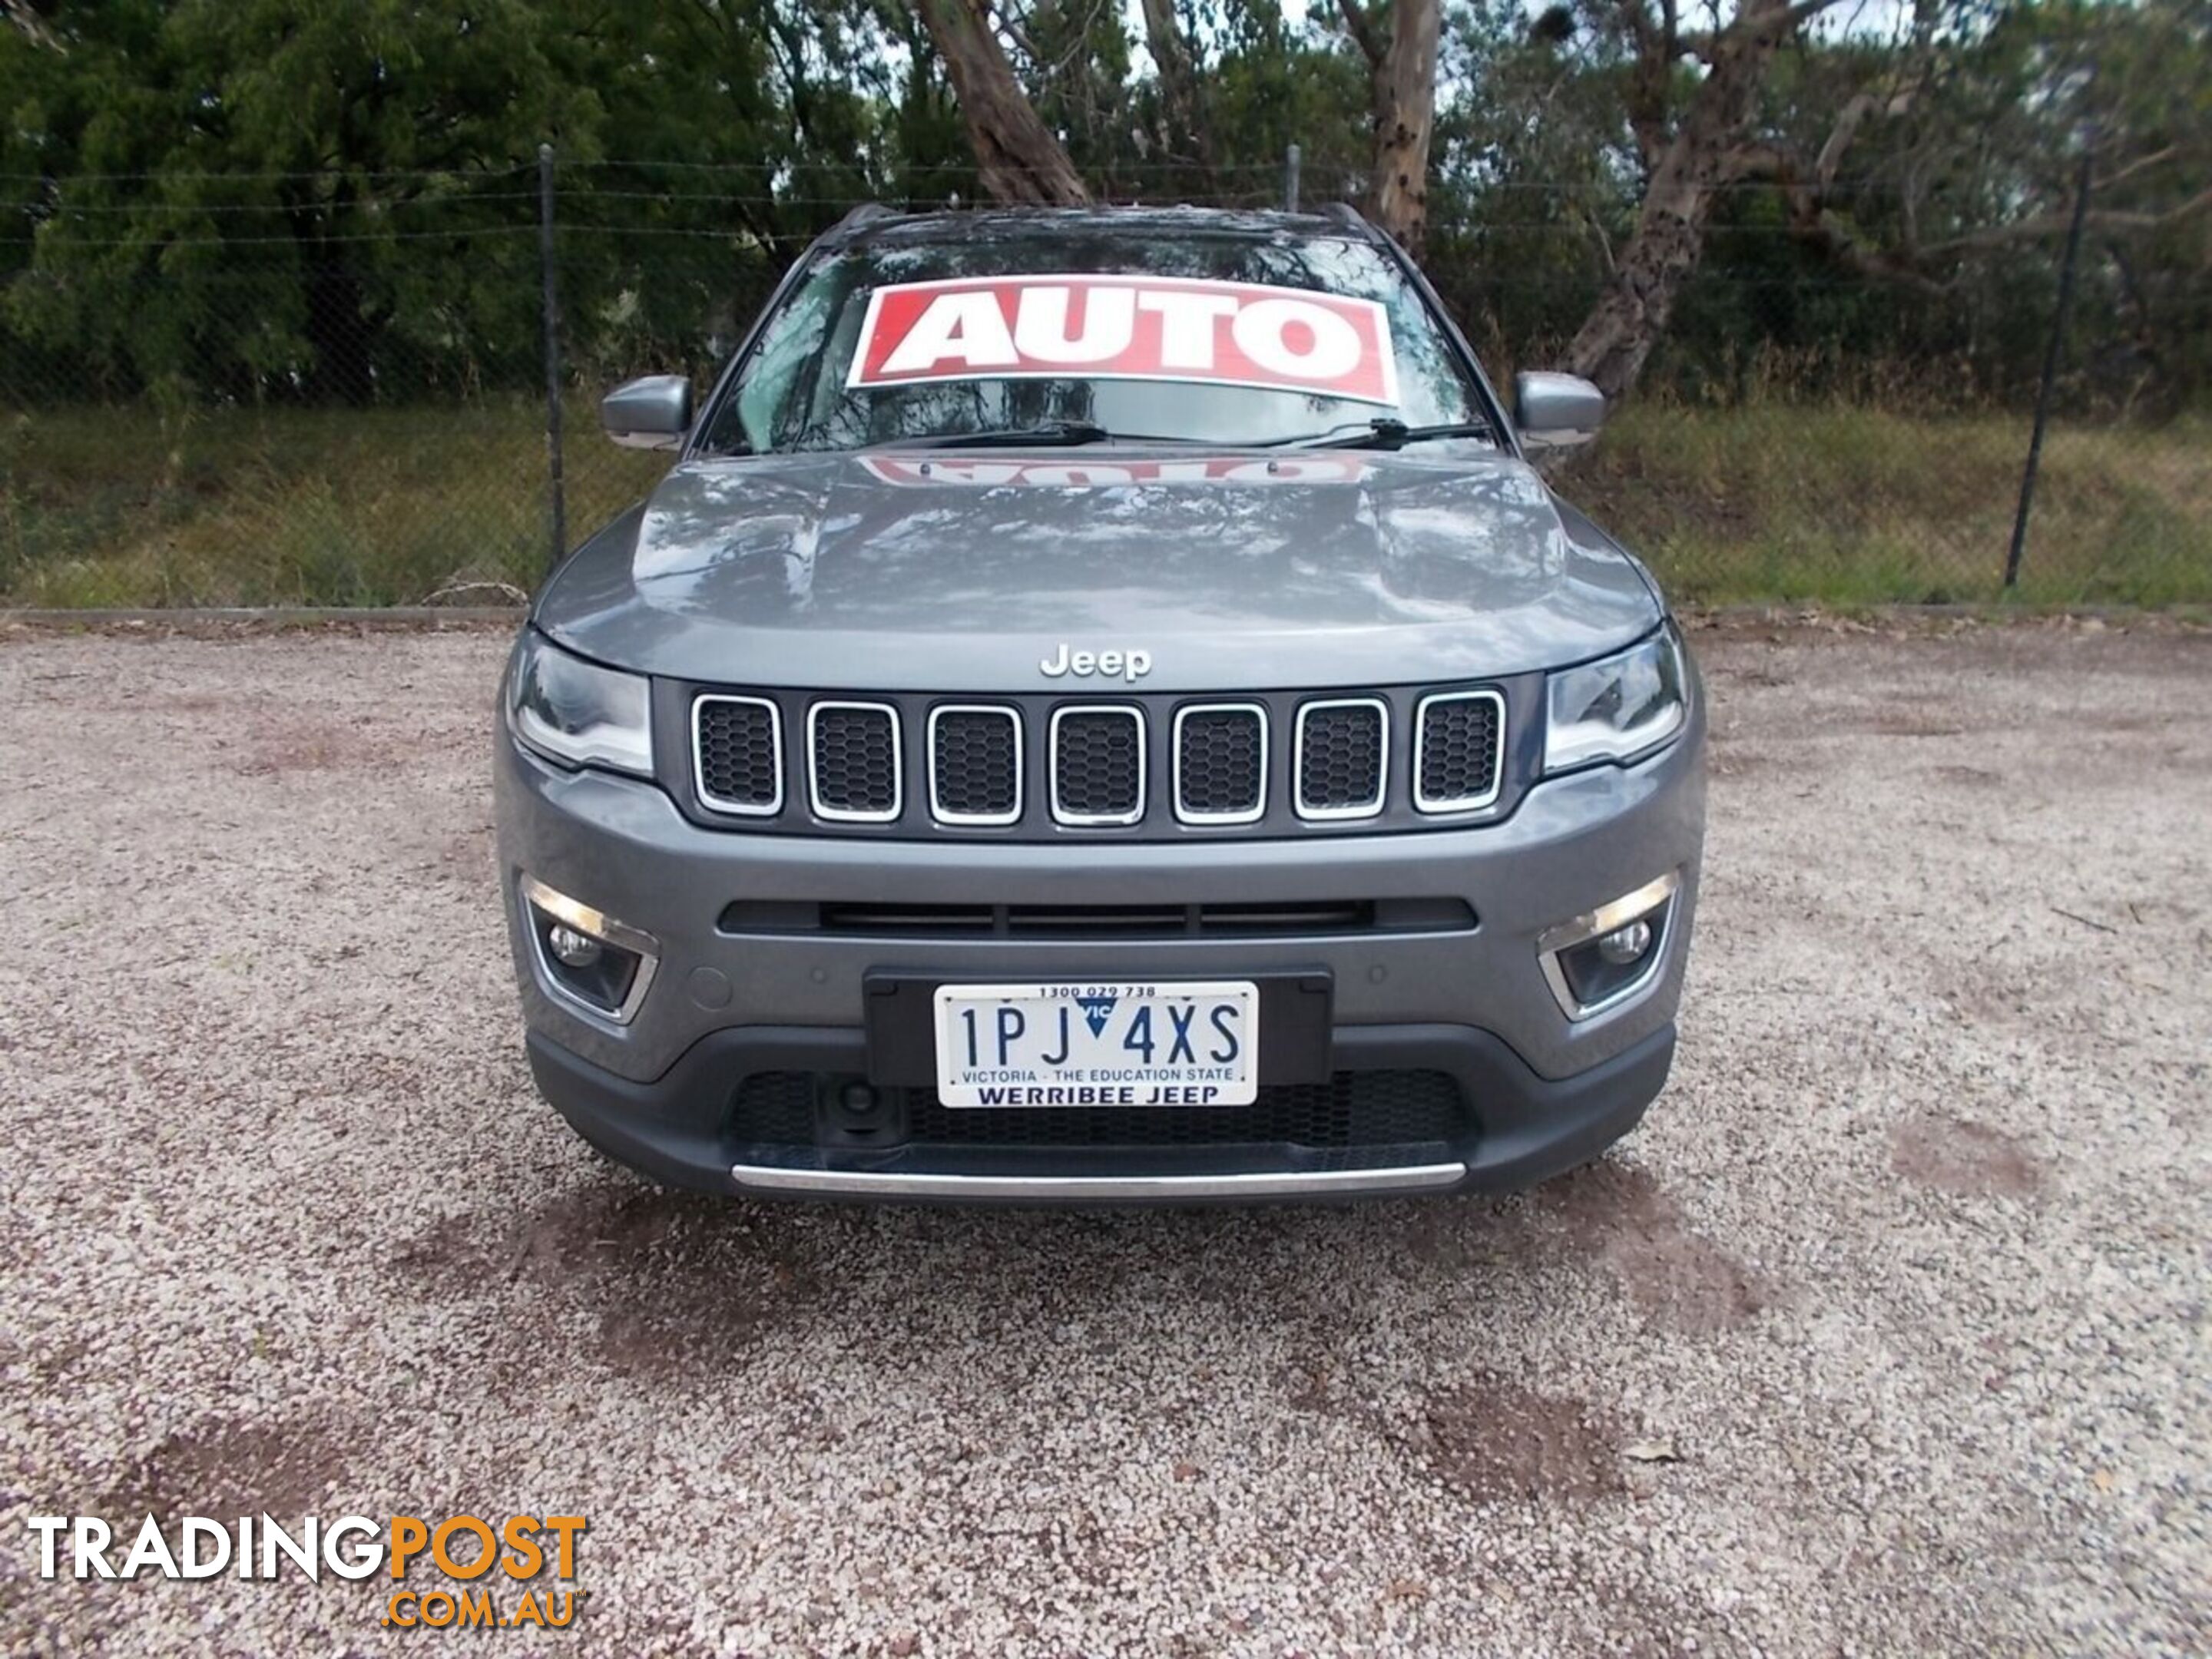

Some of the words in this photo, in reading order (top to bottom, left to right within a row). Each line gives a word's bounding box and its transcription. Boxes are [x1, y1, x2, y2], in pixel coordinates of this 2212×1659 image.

[880, 286, 1362, 379] AUTO
[1040, 643, 1151, 682] Jeep
[1040, 986, 1080, 998] 1300
[1087, 986, 1117, 997] 029
[1125, 986, 1155, 997] 738
[1082, 1005, 1111, 1019] VIC
[962, 1007, 1069, 1067] 1PJ
[1123, 1005, 1240, 1065] 4XS
[962, 1070, 1037, 1083] VICTORIA
[1055, 1069, 1084, 1081] THE
[1090, 1068, 1181, 1081] EDUCATION
[1187, 1068, 1233, 1081] STATE
[978, 1086, 1134, 1105] WERRIBEE
[1145, 1086, 1219, 1104] JEEP
